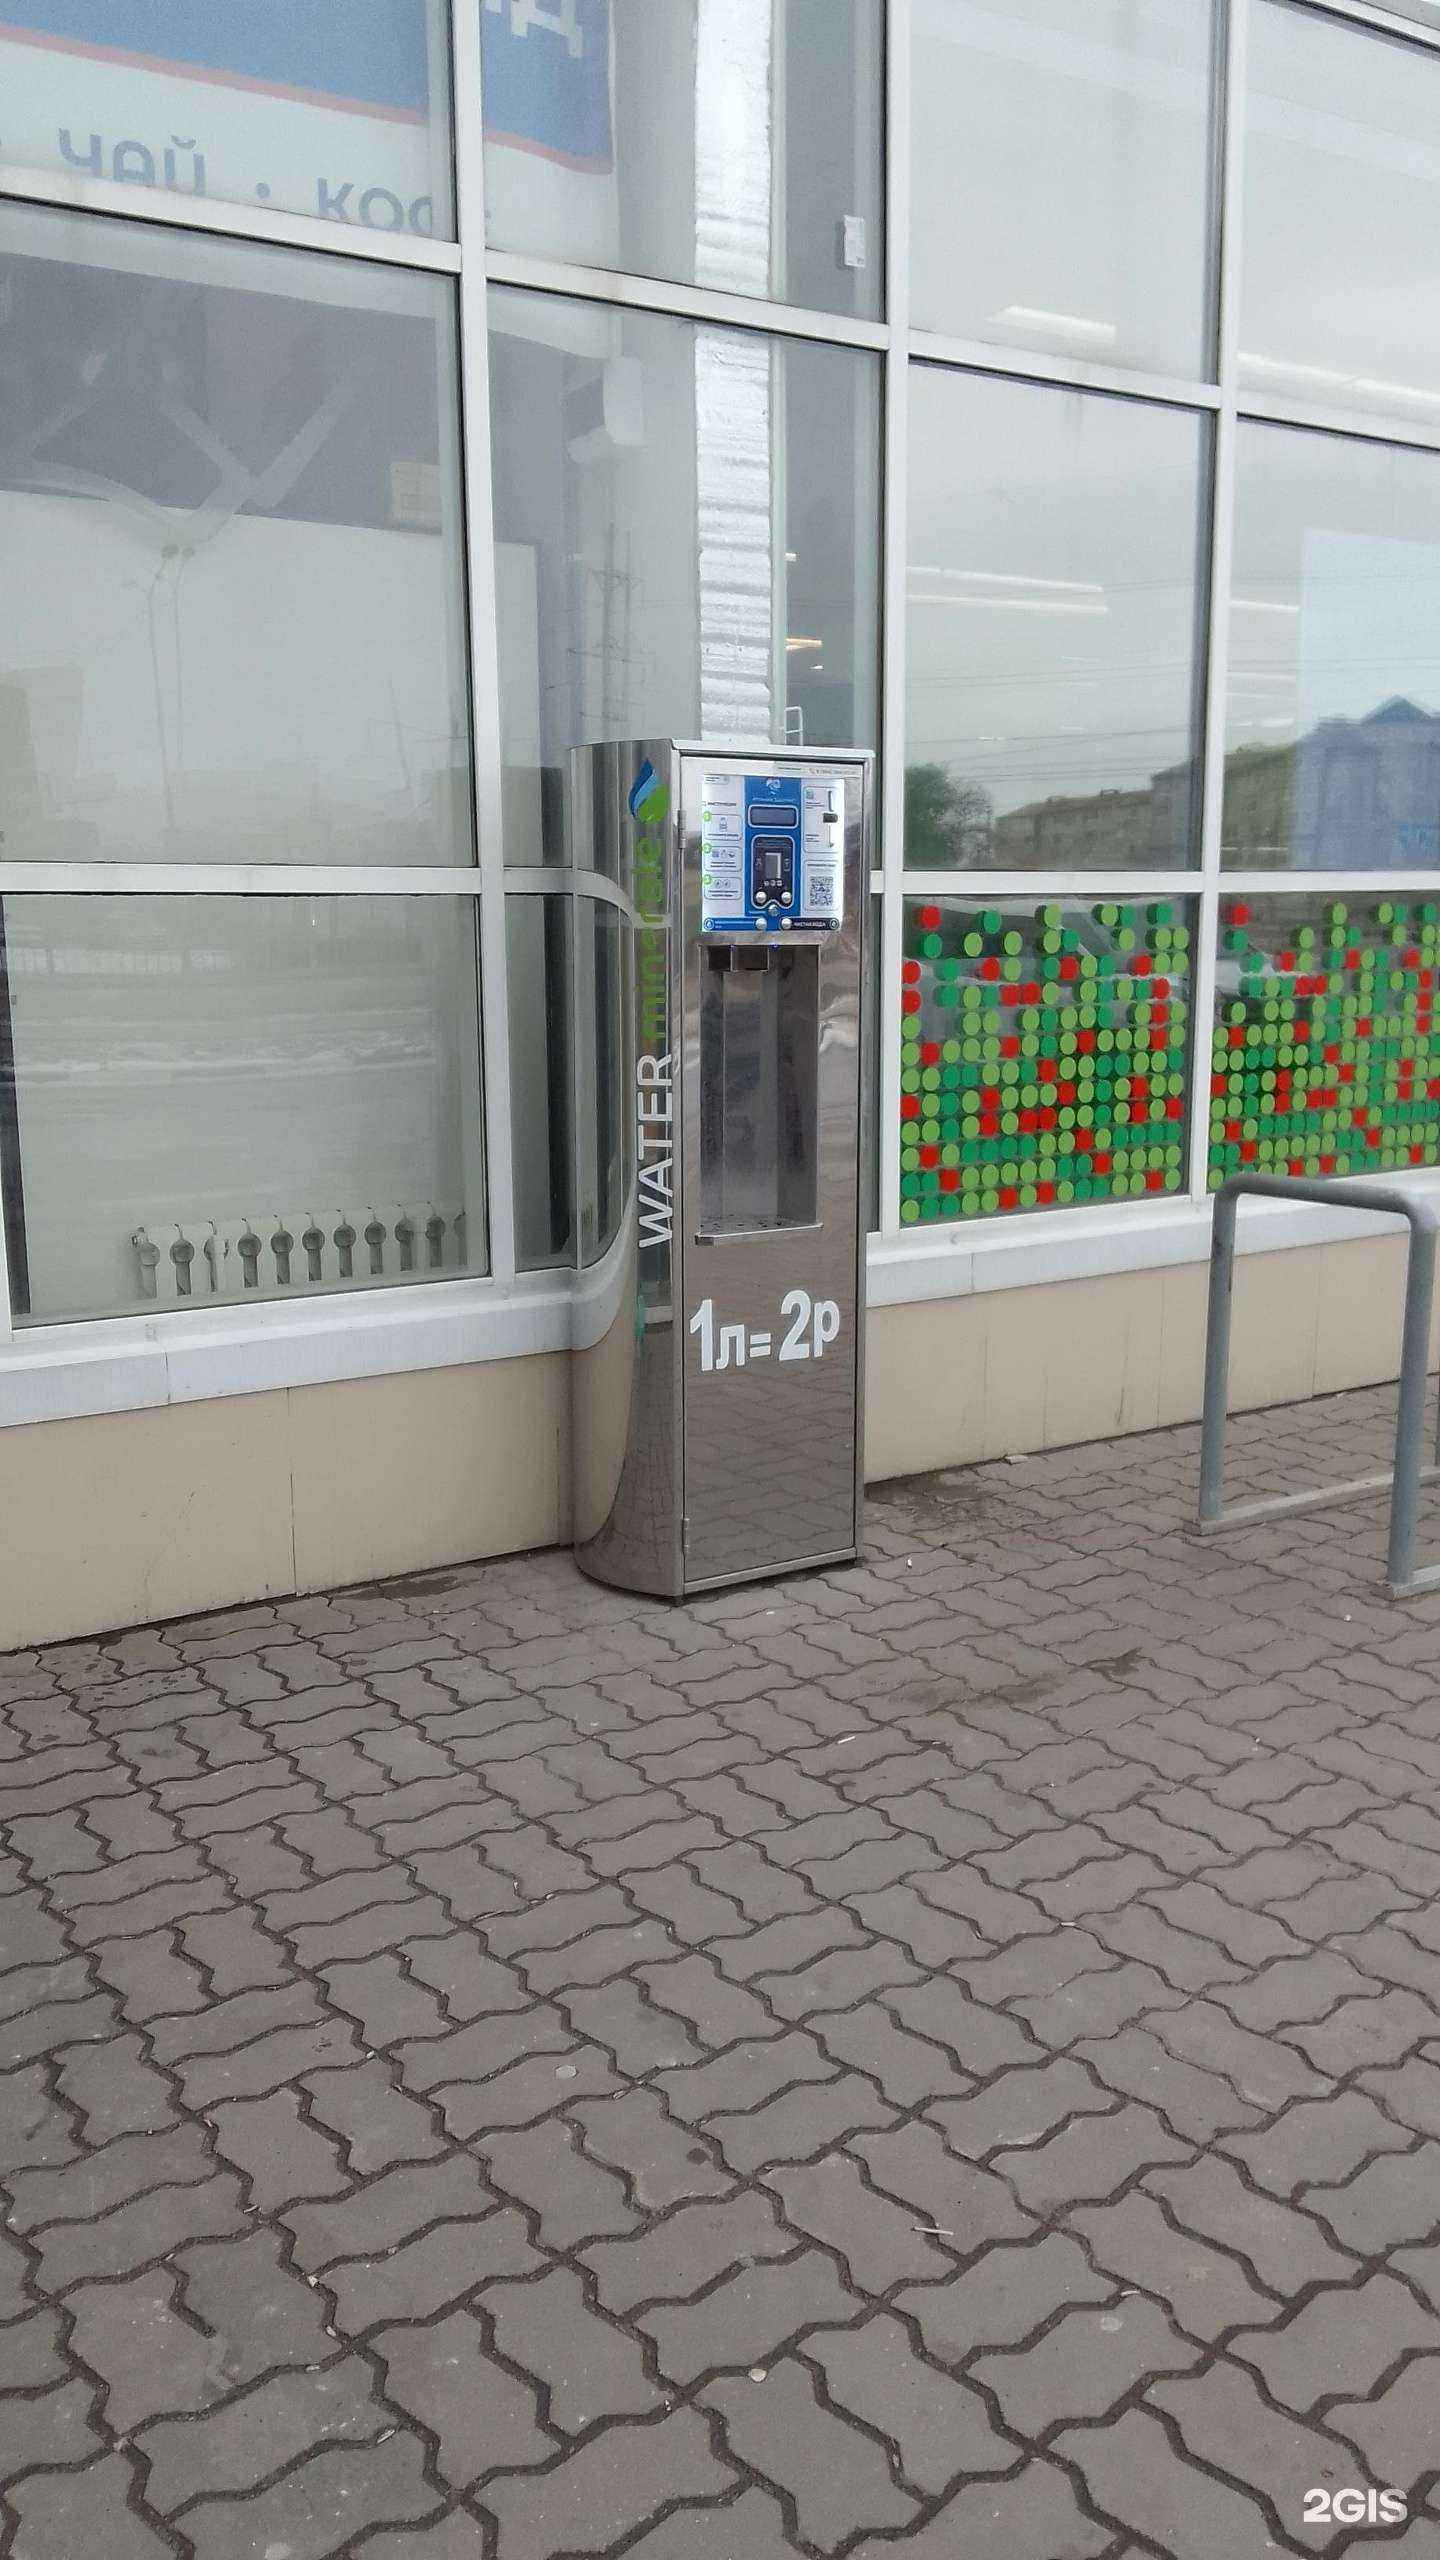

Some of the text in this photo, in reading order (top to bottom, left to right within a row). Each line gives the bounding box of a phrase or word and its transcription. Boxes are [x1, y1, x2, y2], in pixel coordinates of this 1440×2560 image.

[58, 128, 206, 196] ЧАЙ
[637, 1053, 673, 1248] WATER
[778, 1289, 841, 1362] 2р
